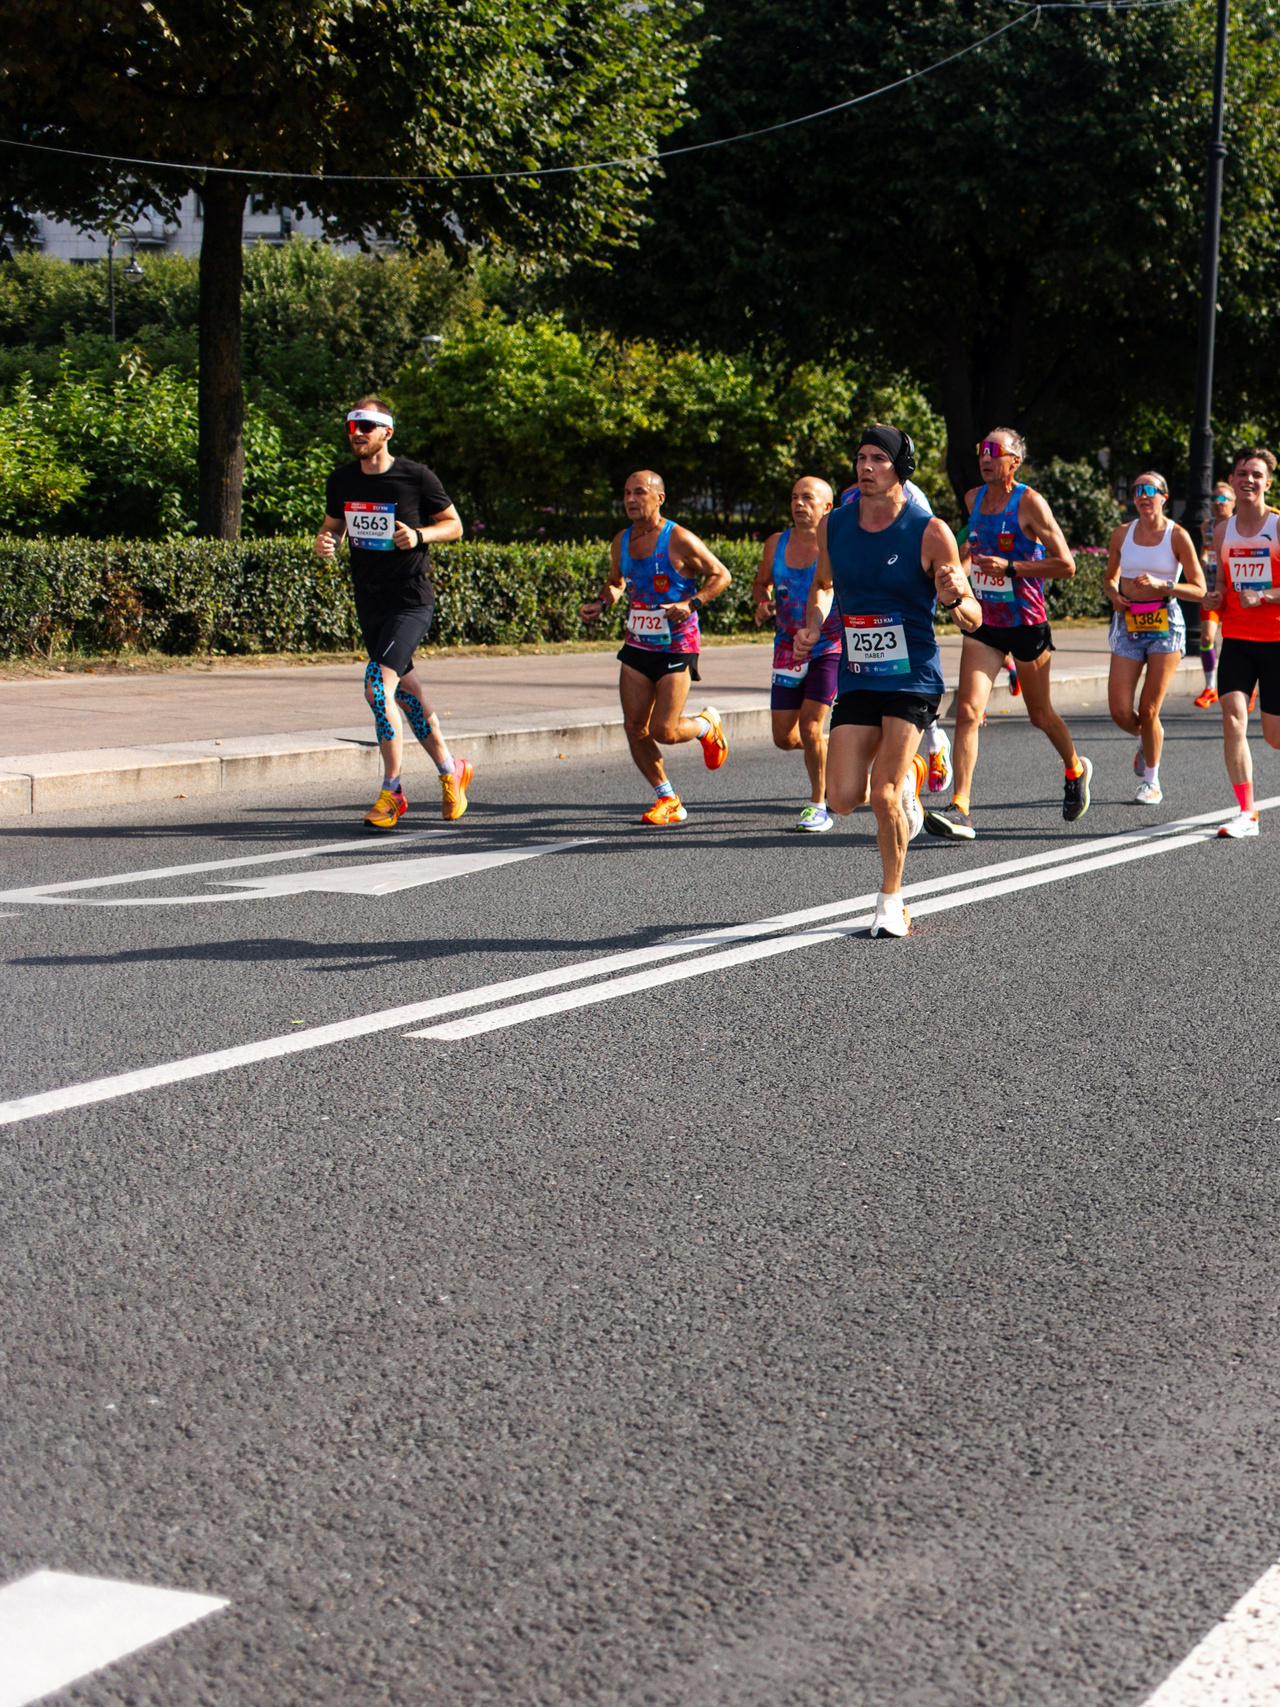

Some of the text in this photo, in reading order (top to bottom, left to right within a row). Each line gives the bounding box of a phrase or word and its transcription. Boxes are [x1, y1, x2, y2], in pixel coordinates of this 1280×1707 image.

[352, 515, 388, 531] 4563
[1233, 563, 1265, 578] 7177
[973, 570, 1005, 587] 7738
[1131, 612, 1163, 626] 1384
[852, 631, 898, 652] 2523
[853, 663, 861, 674] D
